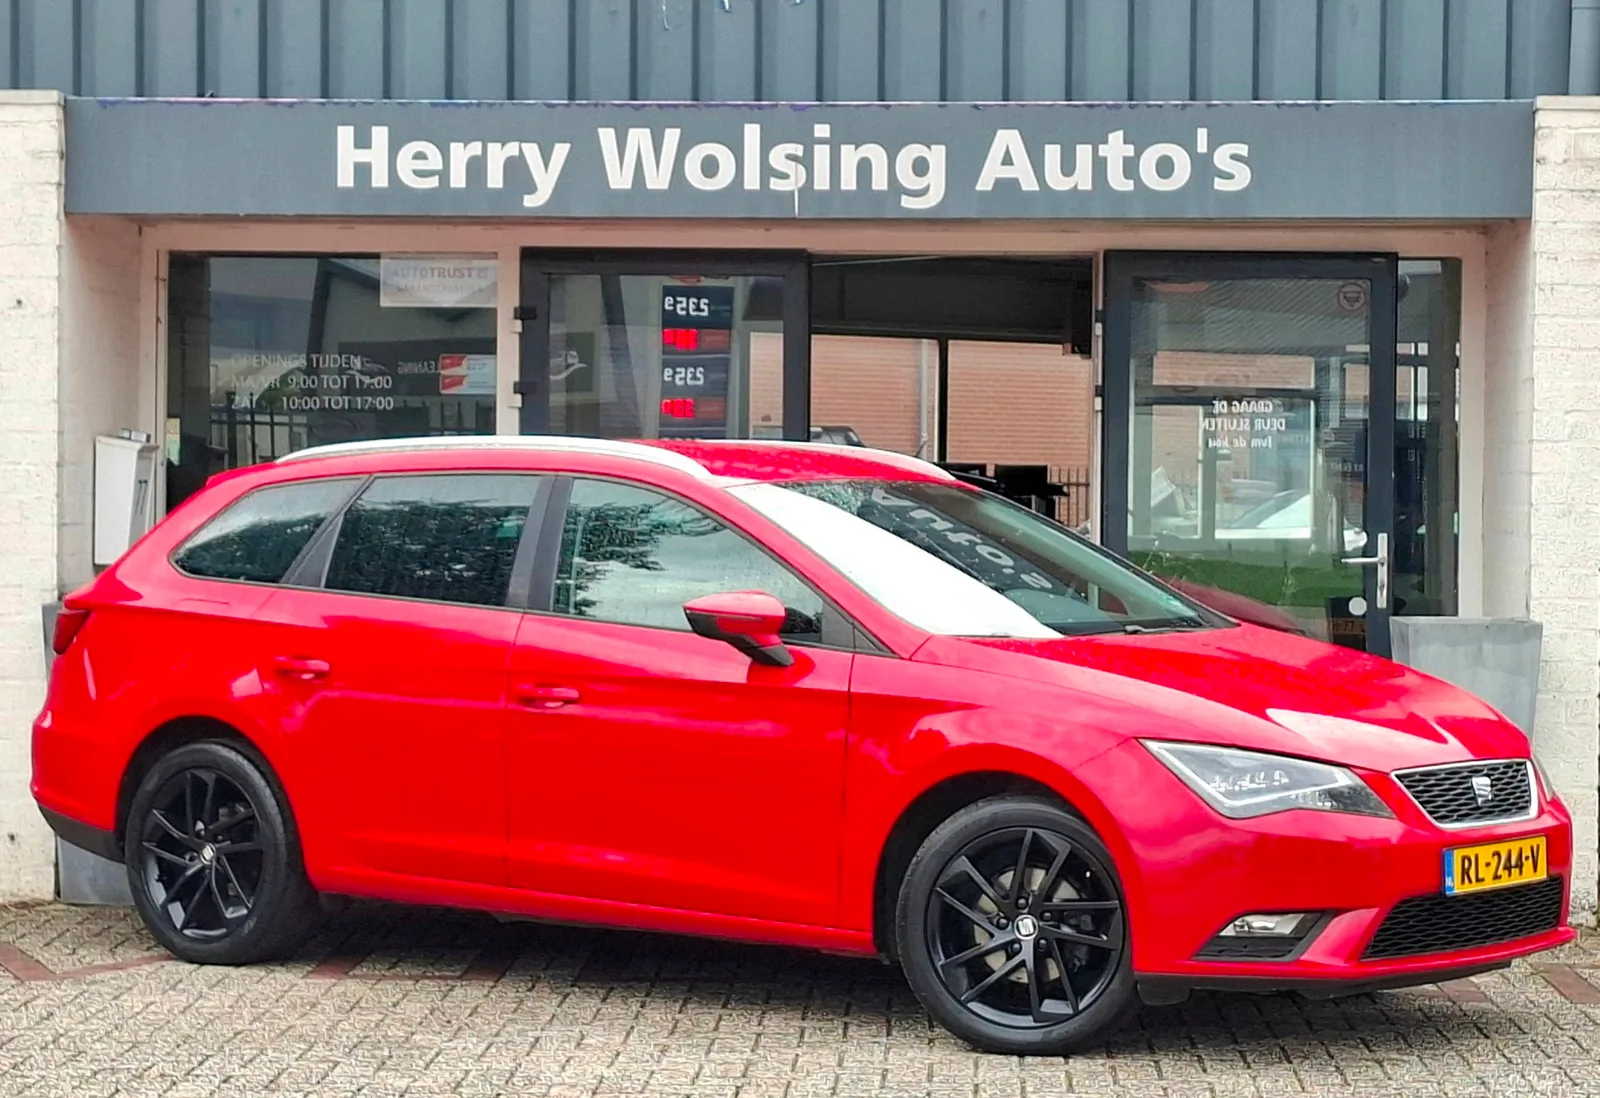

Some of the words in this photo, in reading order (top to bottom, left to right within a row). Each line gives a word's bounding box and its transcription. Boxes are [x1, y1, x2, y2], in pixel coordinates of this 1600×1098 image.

[337, 125, 571, 208] Herry
[598, 123, 947, 209] Wolsing
[975, 127, 1251, 192] Auto's
[392, 266, 472, 278] AUTOTRUST
[321, 374, 351, 388] TOT
[282, 395, 320, 410] 10:00
[321, 395, 351, 409] TOT
[355, 395, 395, 410] 17:00
[1461, 843, 1540, 885] RL-244-V
